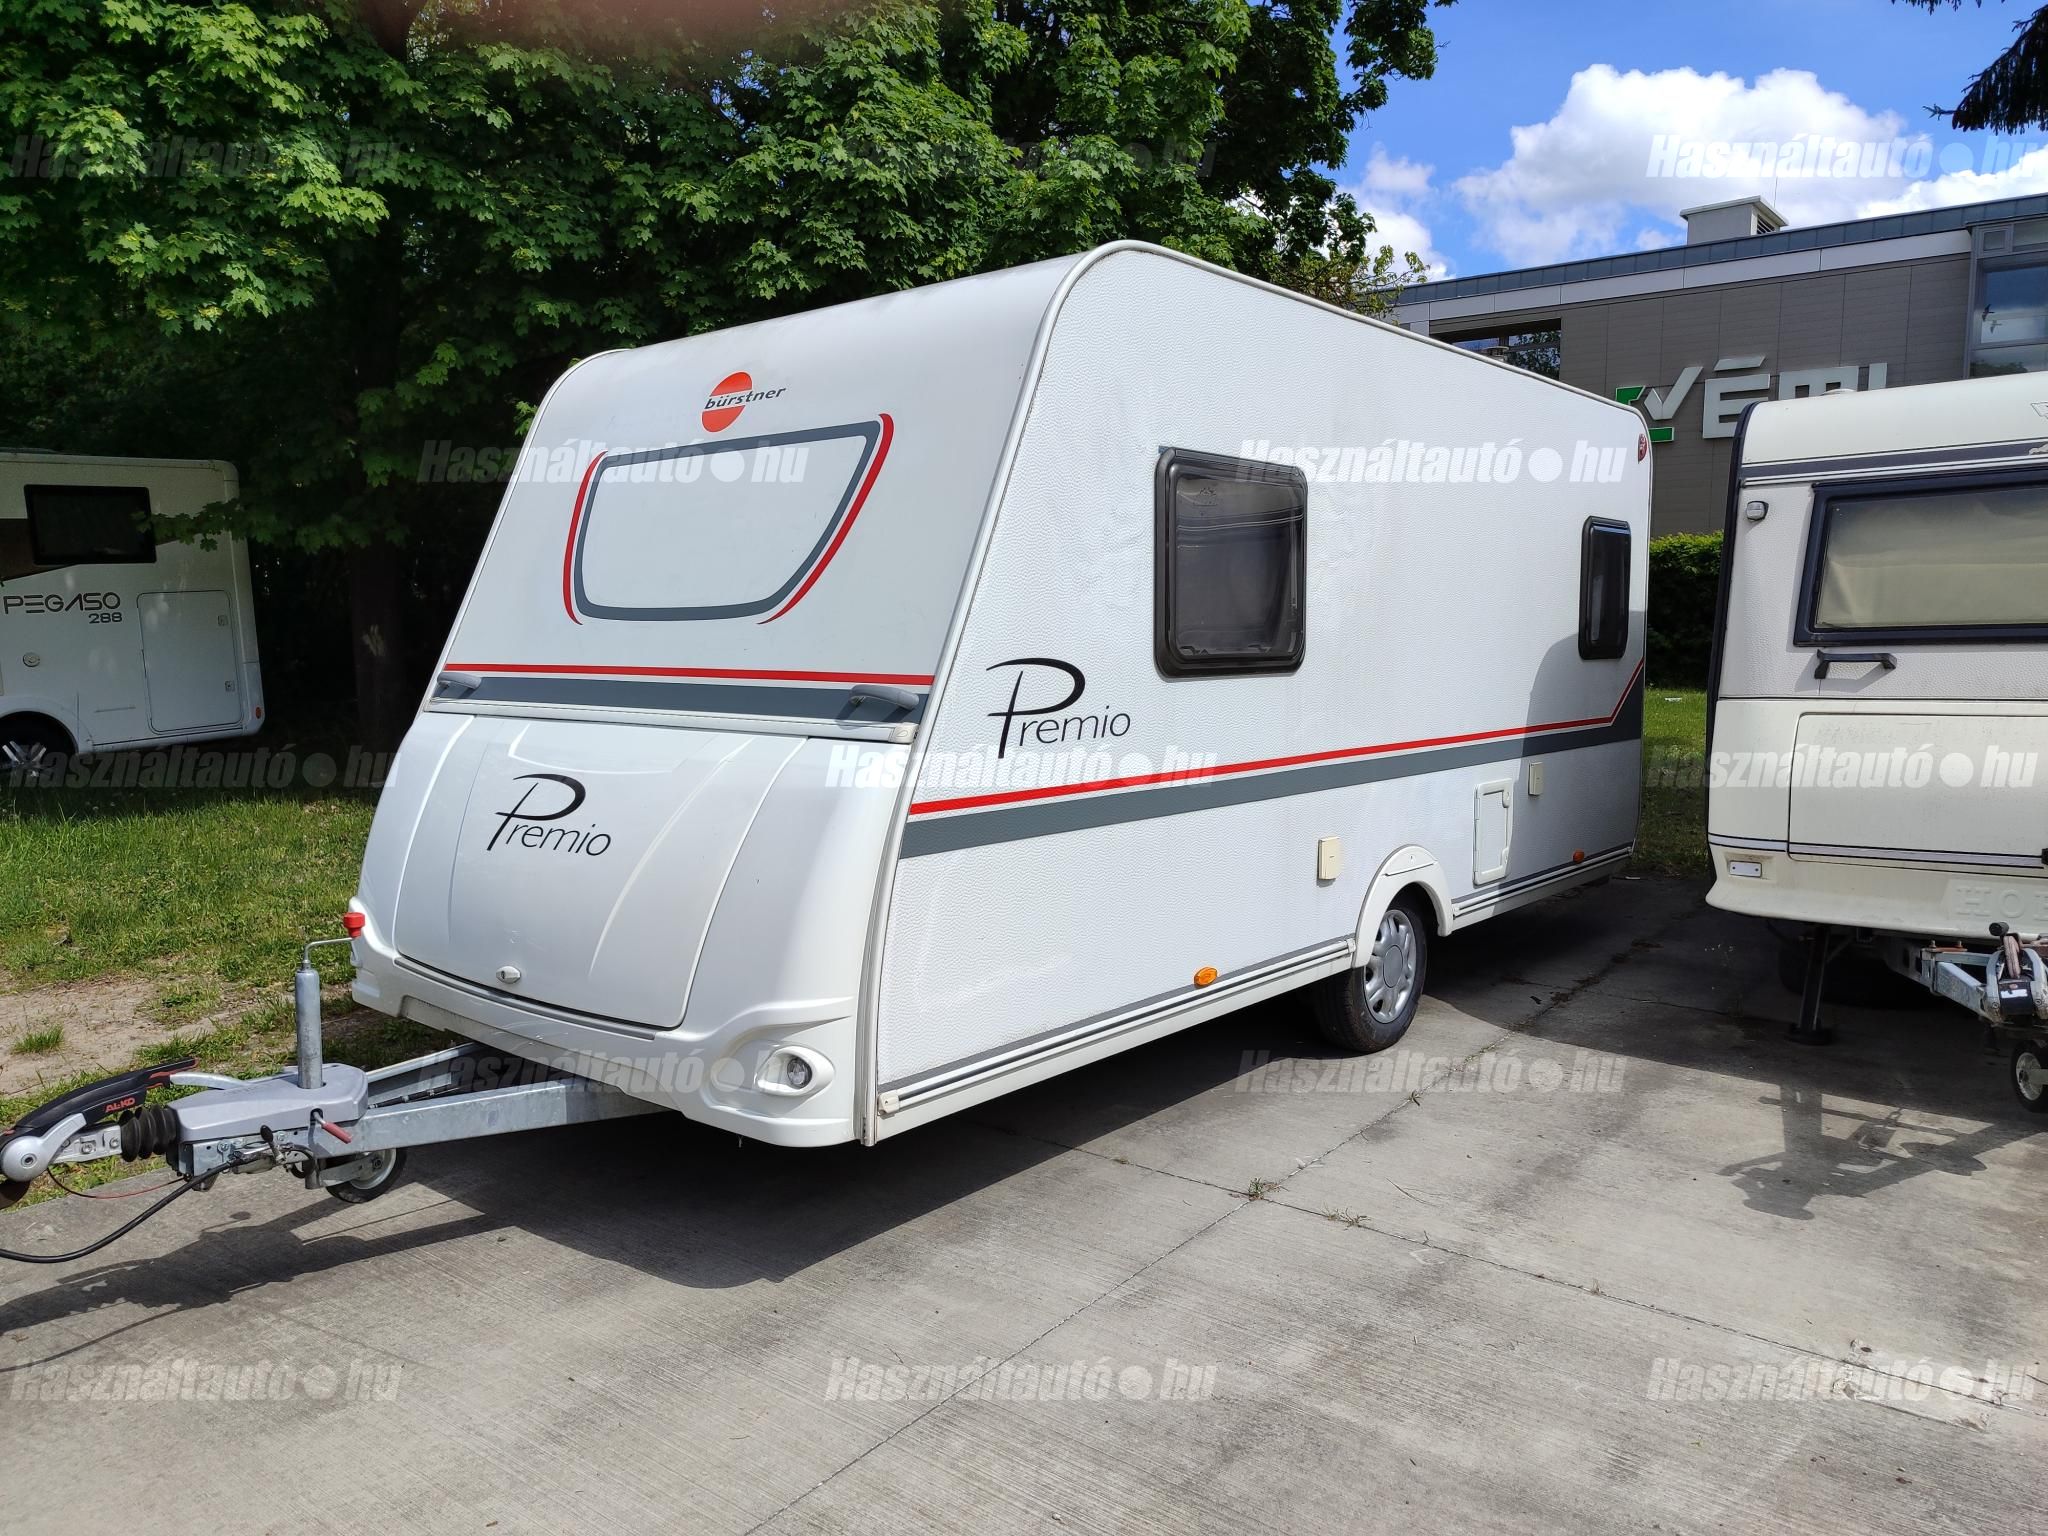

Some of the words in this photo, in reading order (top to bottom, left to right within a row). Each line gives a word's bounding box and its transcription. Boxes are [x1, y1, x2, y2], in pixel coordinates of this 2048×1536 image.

[704, 387, 786, 409] bürstner
[3, 591, 121, 614] PEGASO
[88, 611, 123, 624] 288
[985, 657, 1131, 759] Premio
[486, 773, 612, 856] Premio
